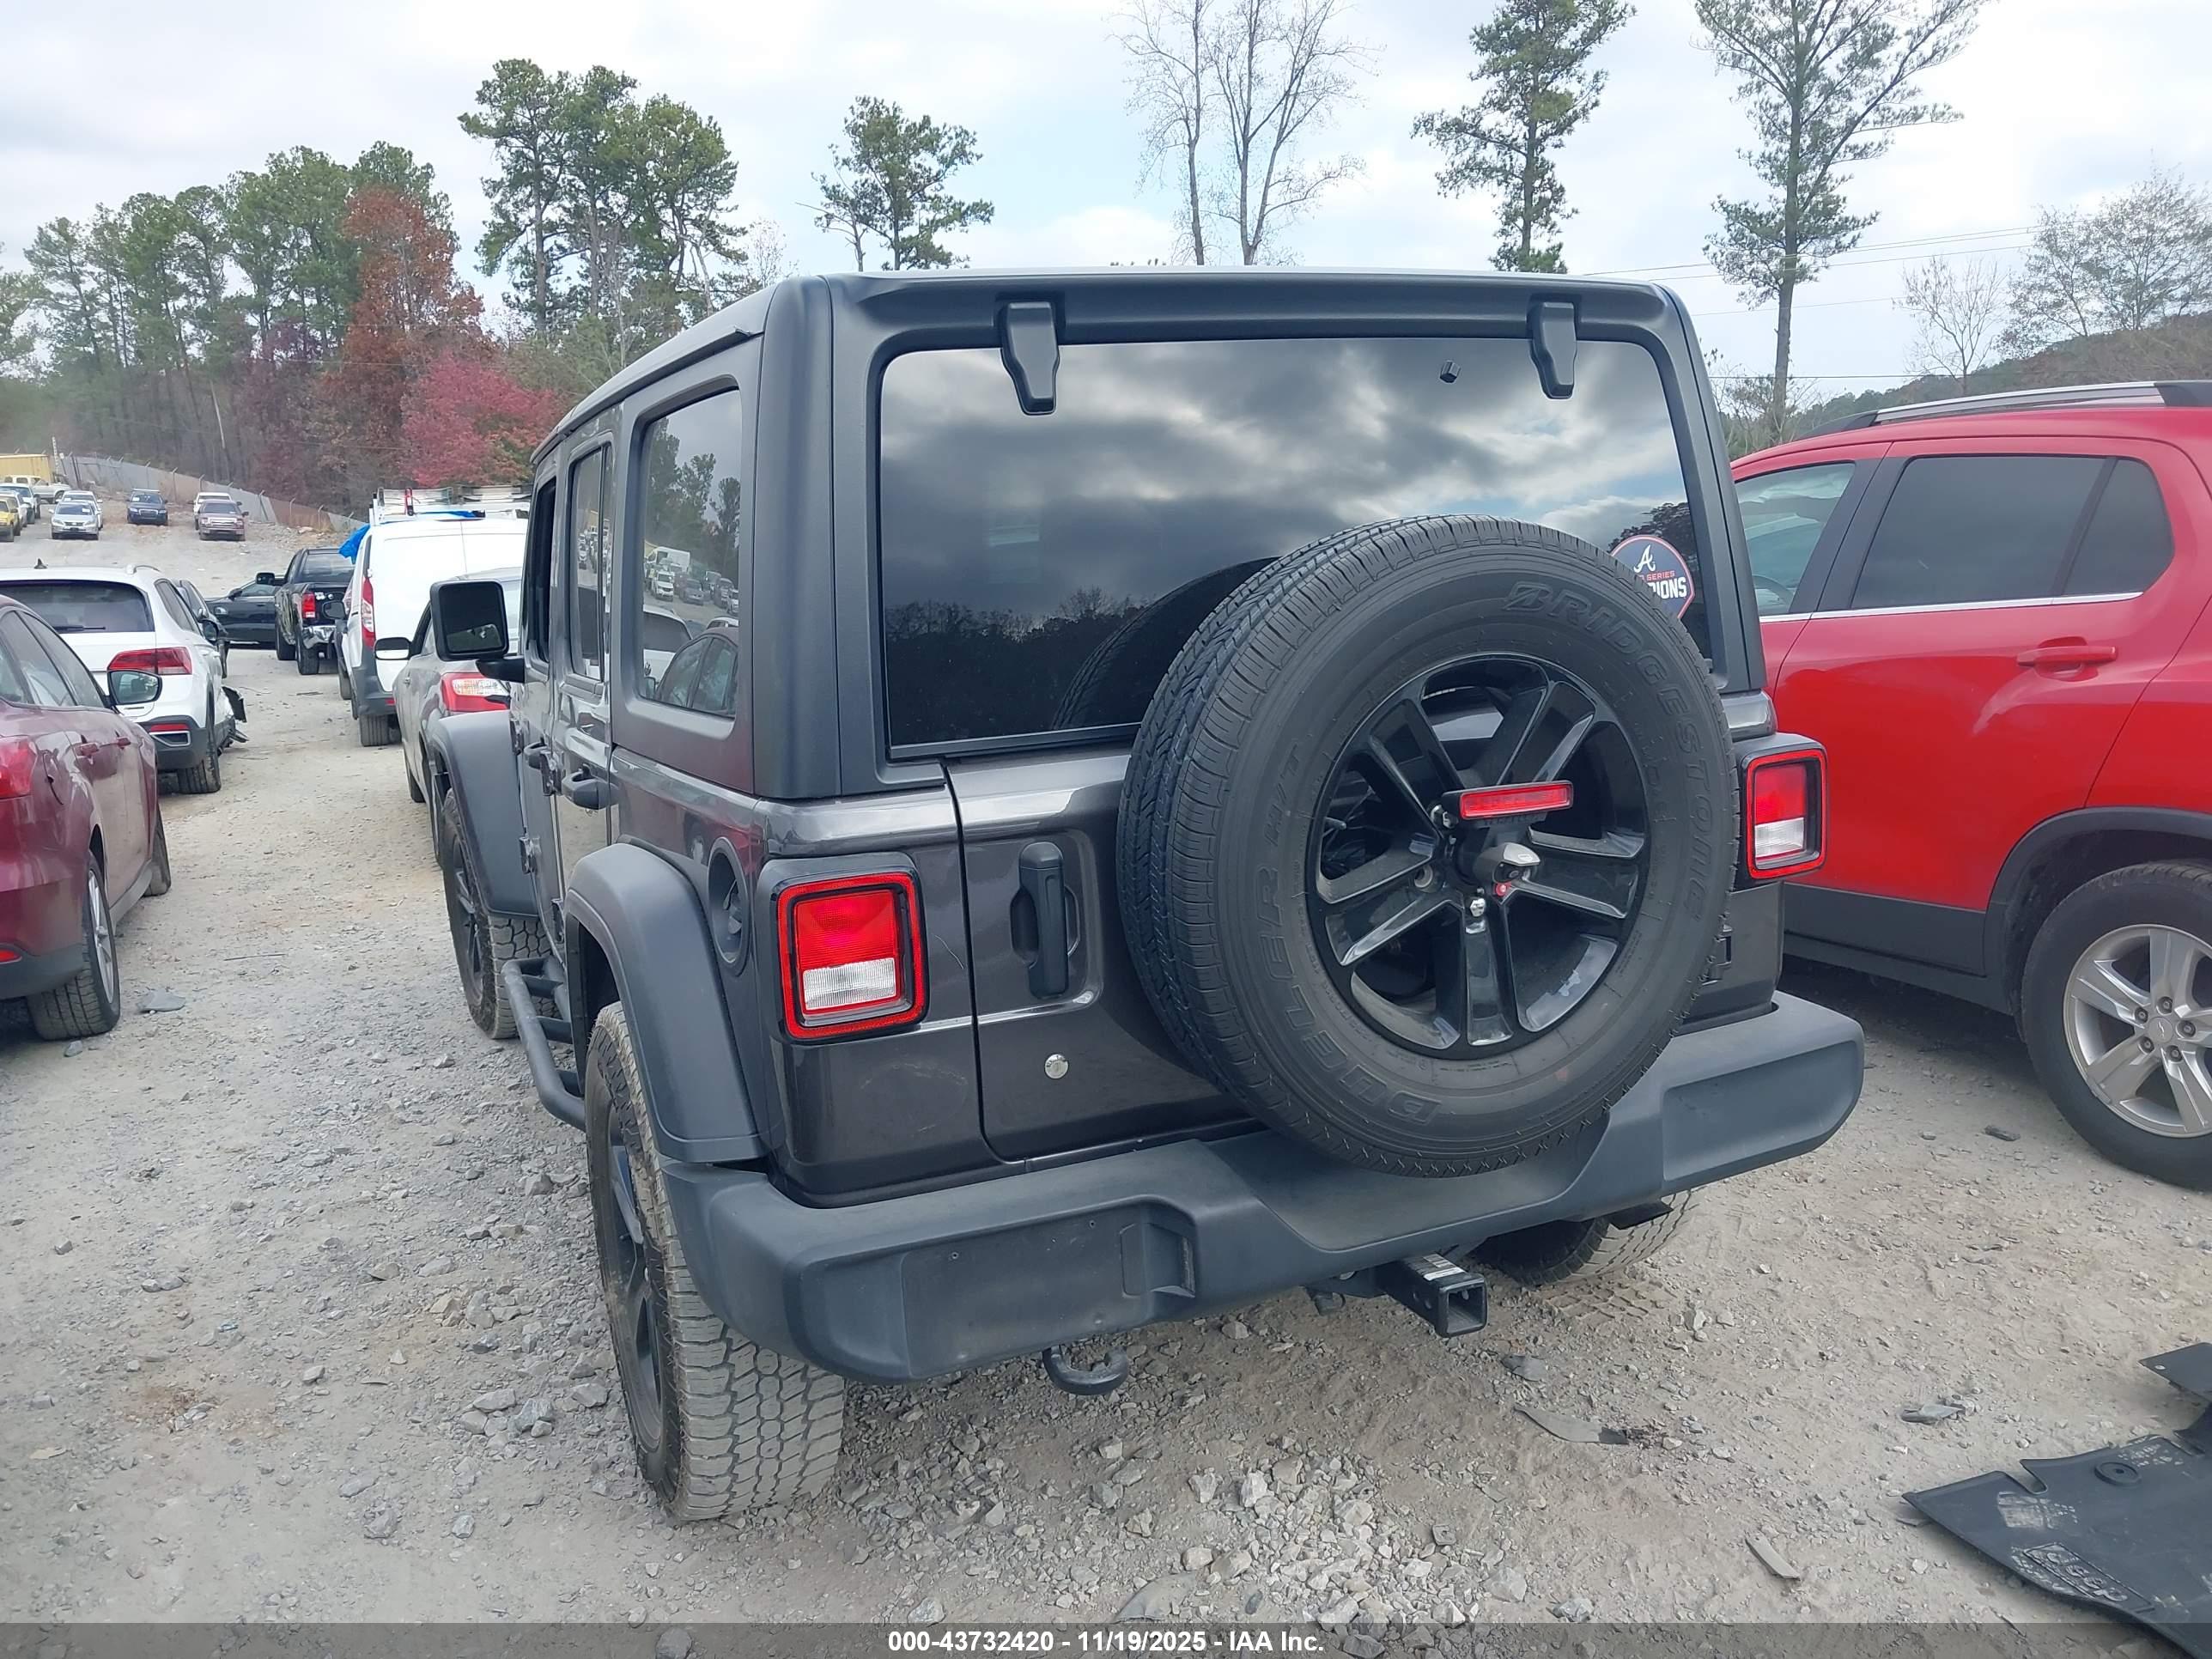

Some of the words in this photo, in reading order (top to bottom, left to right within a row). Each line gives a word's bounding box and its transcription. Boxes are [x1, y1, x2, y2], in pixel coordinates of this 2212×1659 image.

[1646, 570, 1675, 581] SERIES
[1501, 580, 1714, 922] BRIDGESTONE
[1256, 864, 1443, 1125] DUELER
